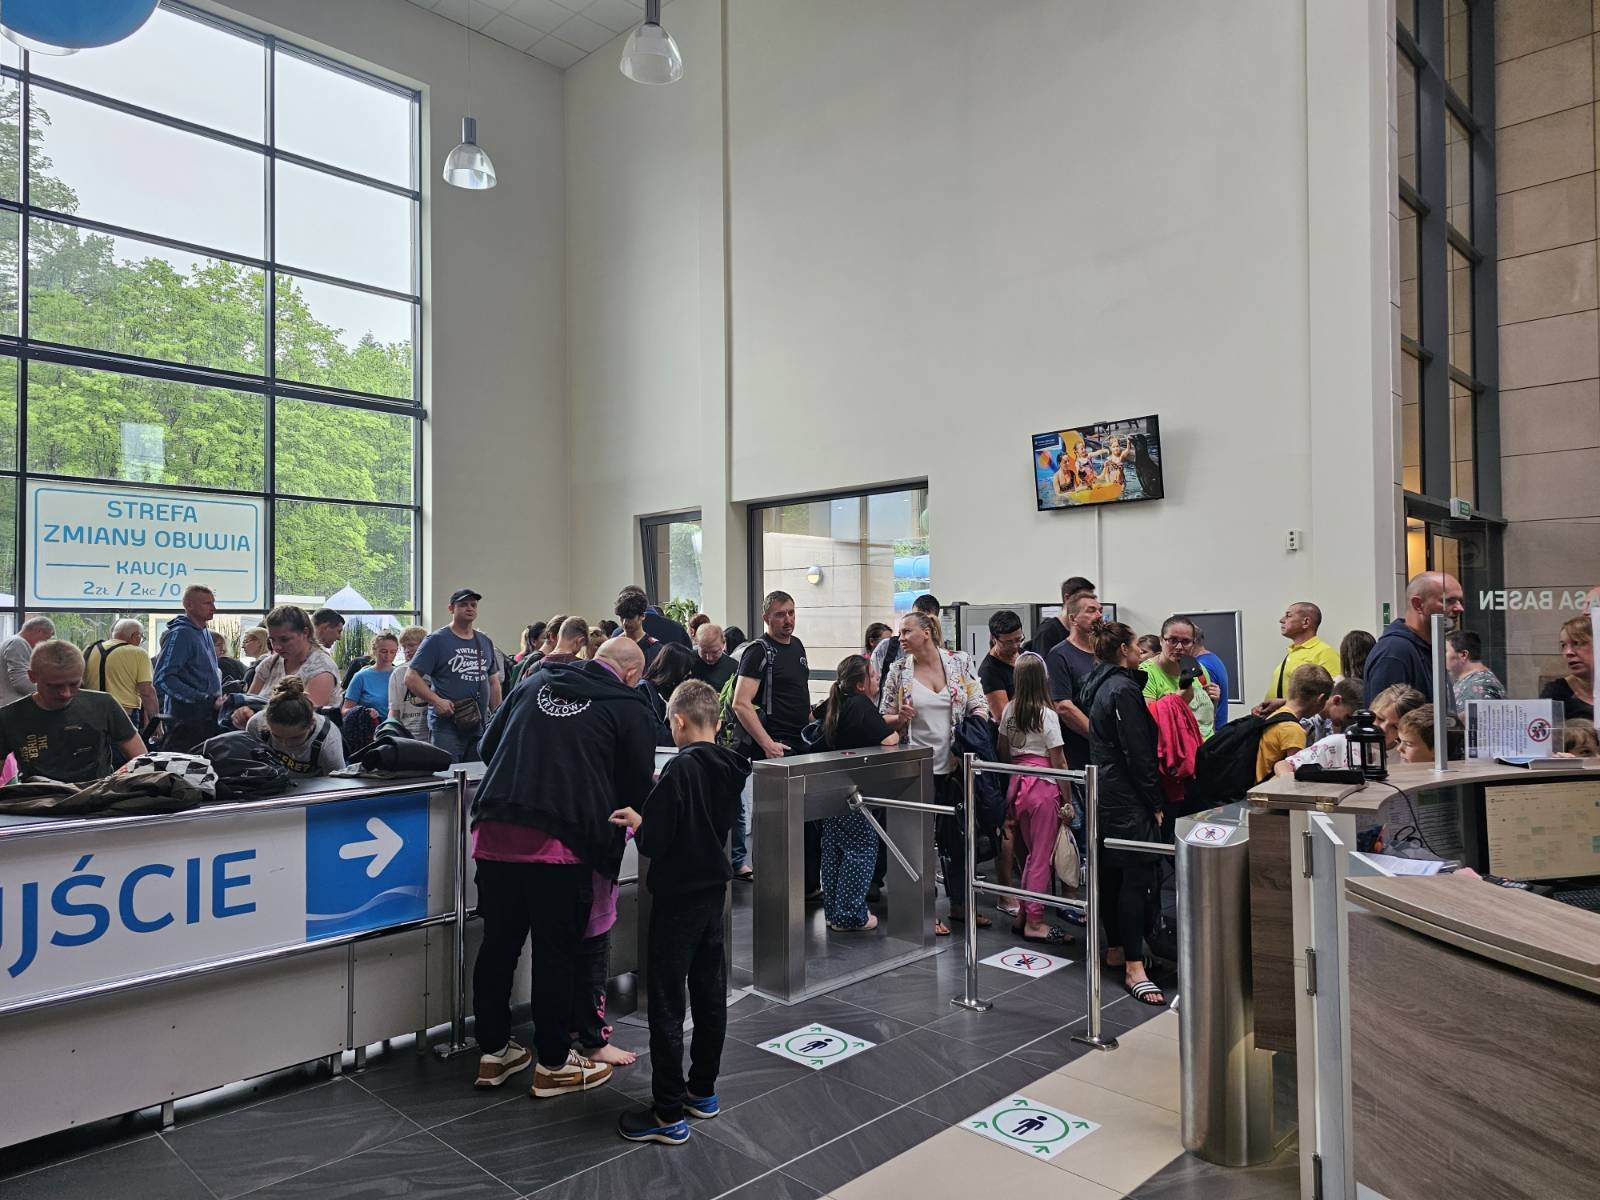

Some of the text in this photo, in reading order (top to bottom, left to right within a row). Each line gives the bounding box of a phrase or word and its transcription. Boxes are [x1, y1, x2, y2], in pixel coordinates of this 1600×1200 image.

[107, 500, 197, 523] STREFA
[43, 524, 250, 552] ZMIANY OBUWIA
[116, 560, 187, 579] KAUCJA
[0, 849, 257, 979] JŚCIE
